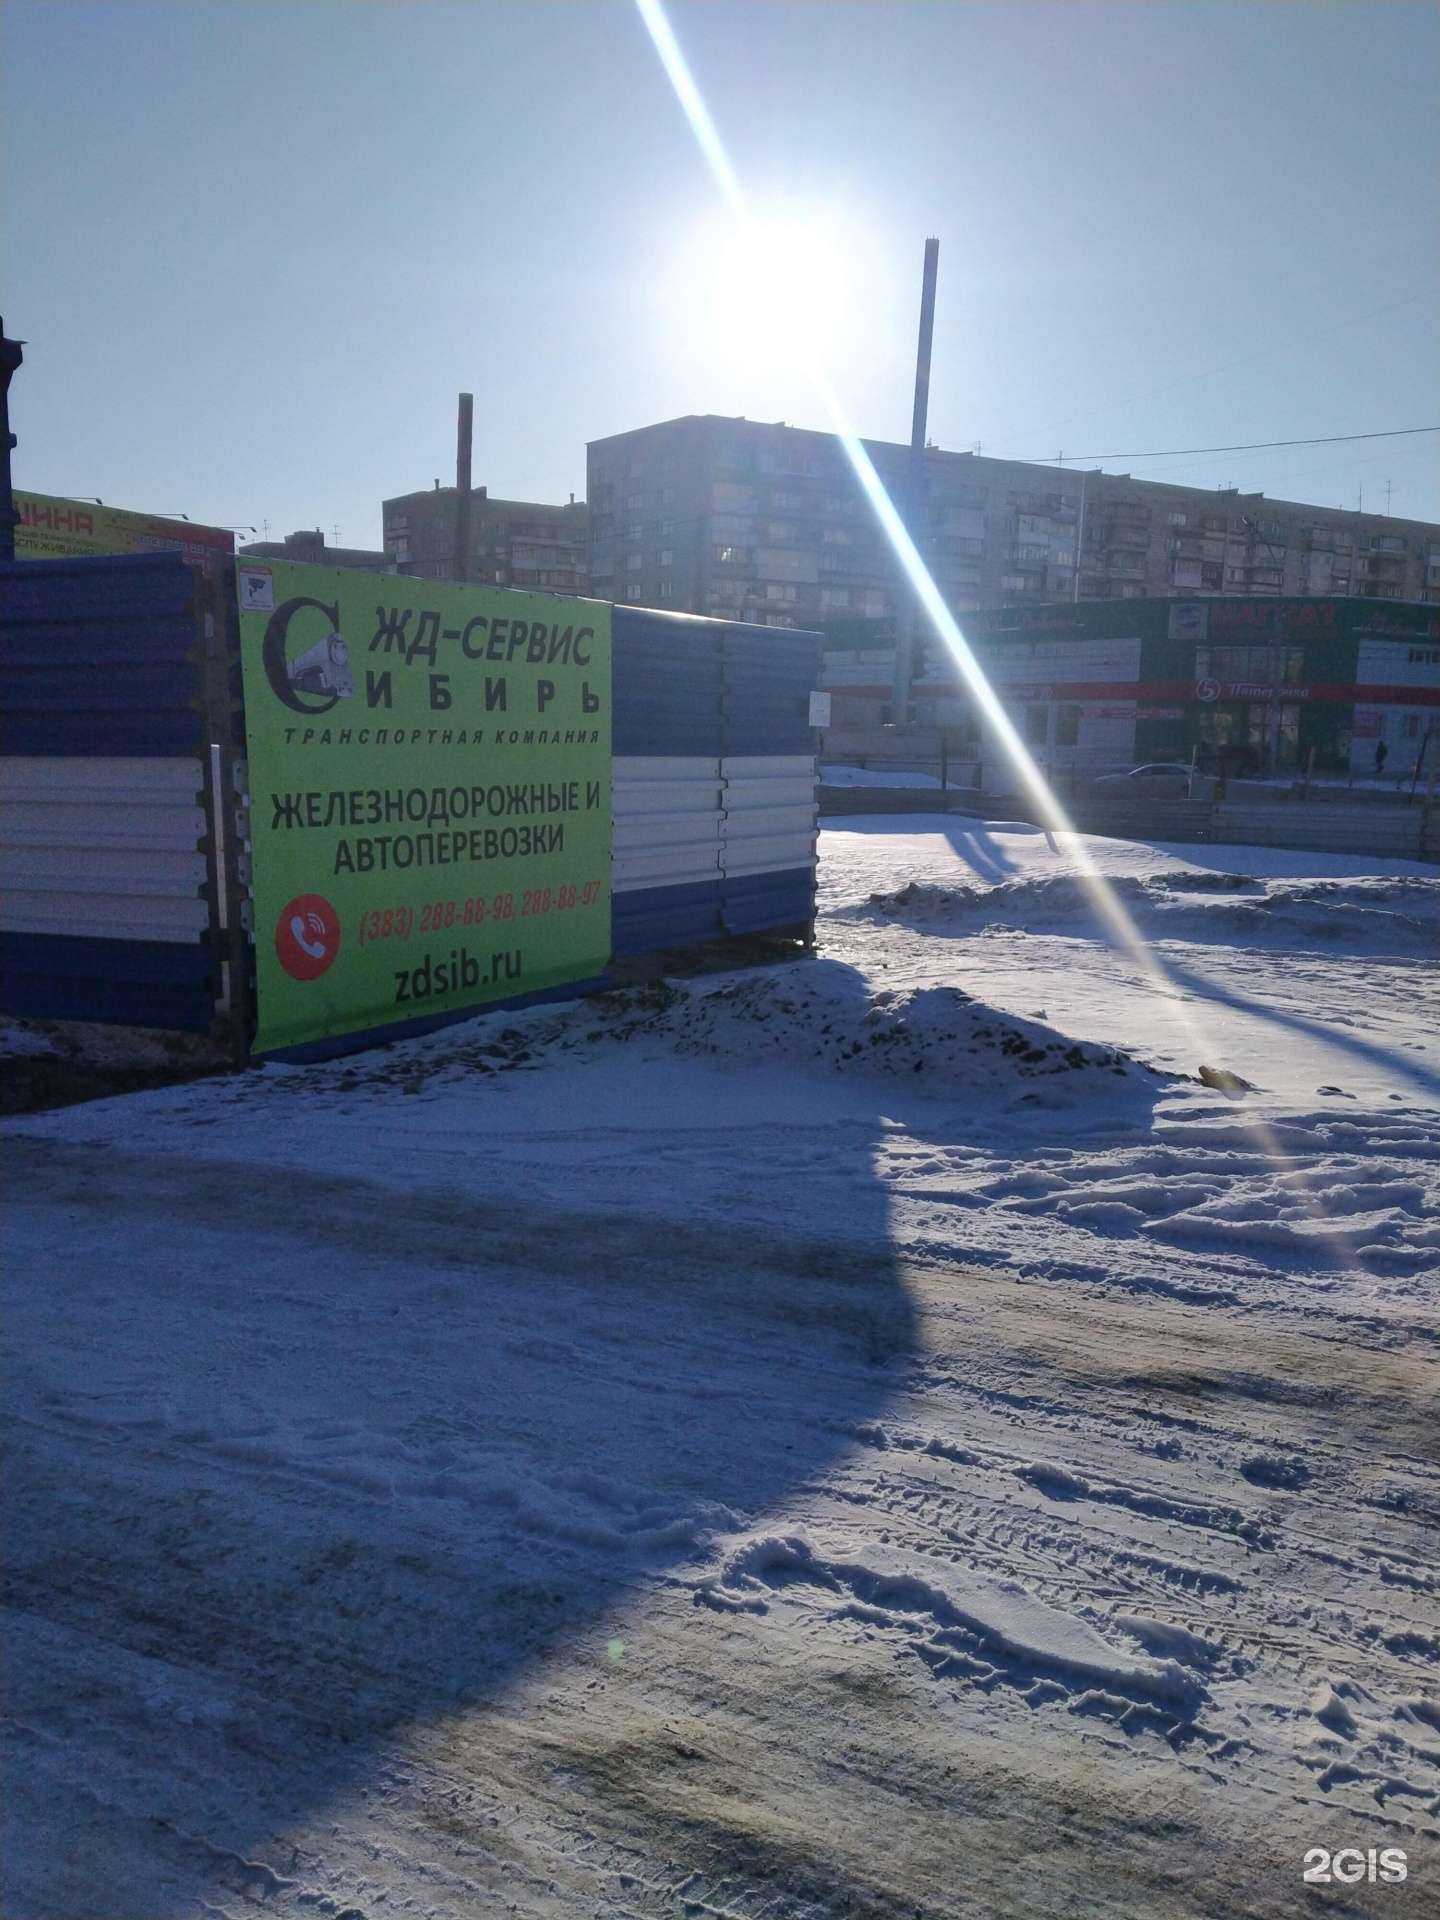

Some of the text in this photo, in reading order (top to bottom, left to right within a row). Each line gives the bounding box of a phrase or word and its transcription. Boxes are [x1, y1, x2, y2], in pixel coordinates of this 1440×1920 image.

[368, 606, 595, 667] ЖД-СЕРВИС
[284, 727, 600, 745] ТРАНСПОРТНАЯ КОМПАНИЯ
[271, 781, 601, 830] ЖЕЛЕЗНОДОРОЖНЫЕ И
[333, 824, 564, 875] АВТОПЕРЕВОЗКИ
[359, 906, 413, 947] (383)
[521, 880, 602, 917] 288-88-97
[395, 949, 522, 1004] zdsib.ru
